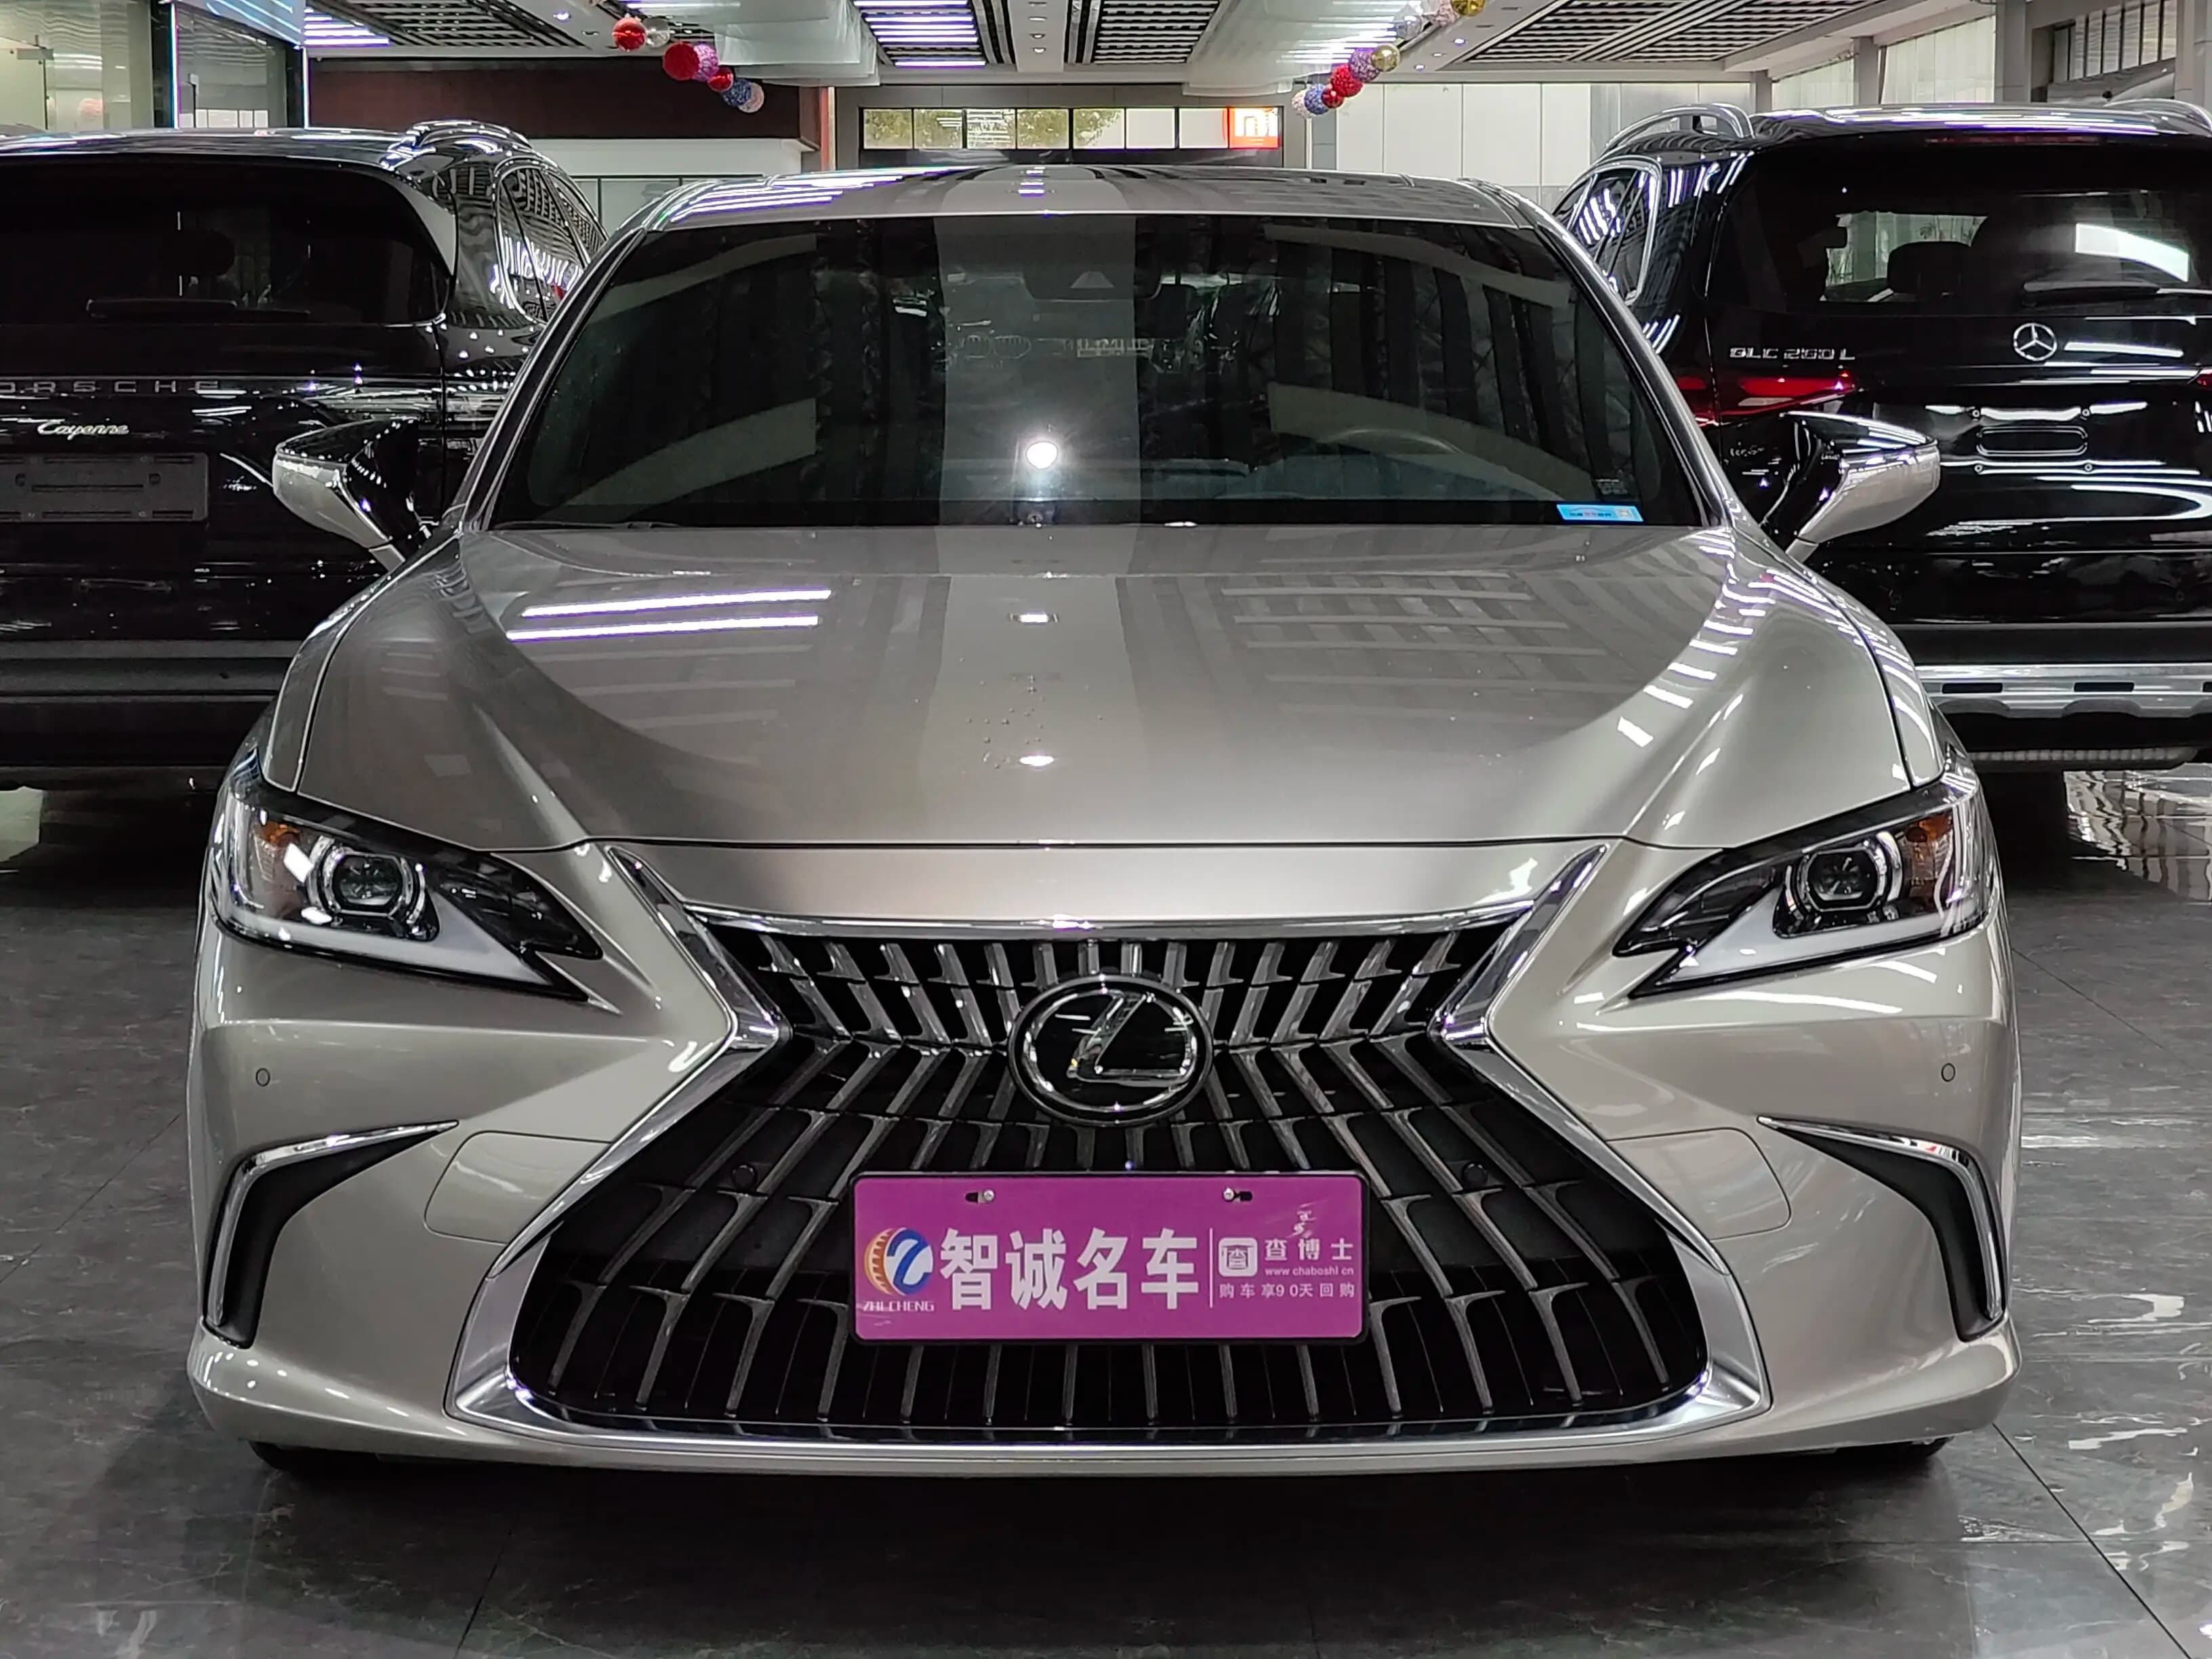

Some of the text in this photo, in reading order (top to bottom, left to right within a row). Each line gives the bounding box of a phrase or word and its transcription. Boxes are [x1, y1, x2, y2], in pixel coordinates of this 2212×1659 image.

[1729, 347, 1779, 359] GLC
[1839, 348, 1856, 361] L
[37, 419, 129, 441] Cayenne
[1265, 1238, 1353, 1261] 查博士
[940, 1227, 1199, 1311] 智诚名车
